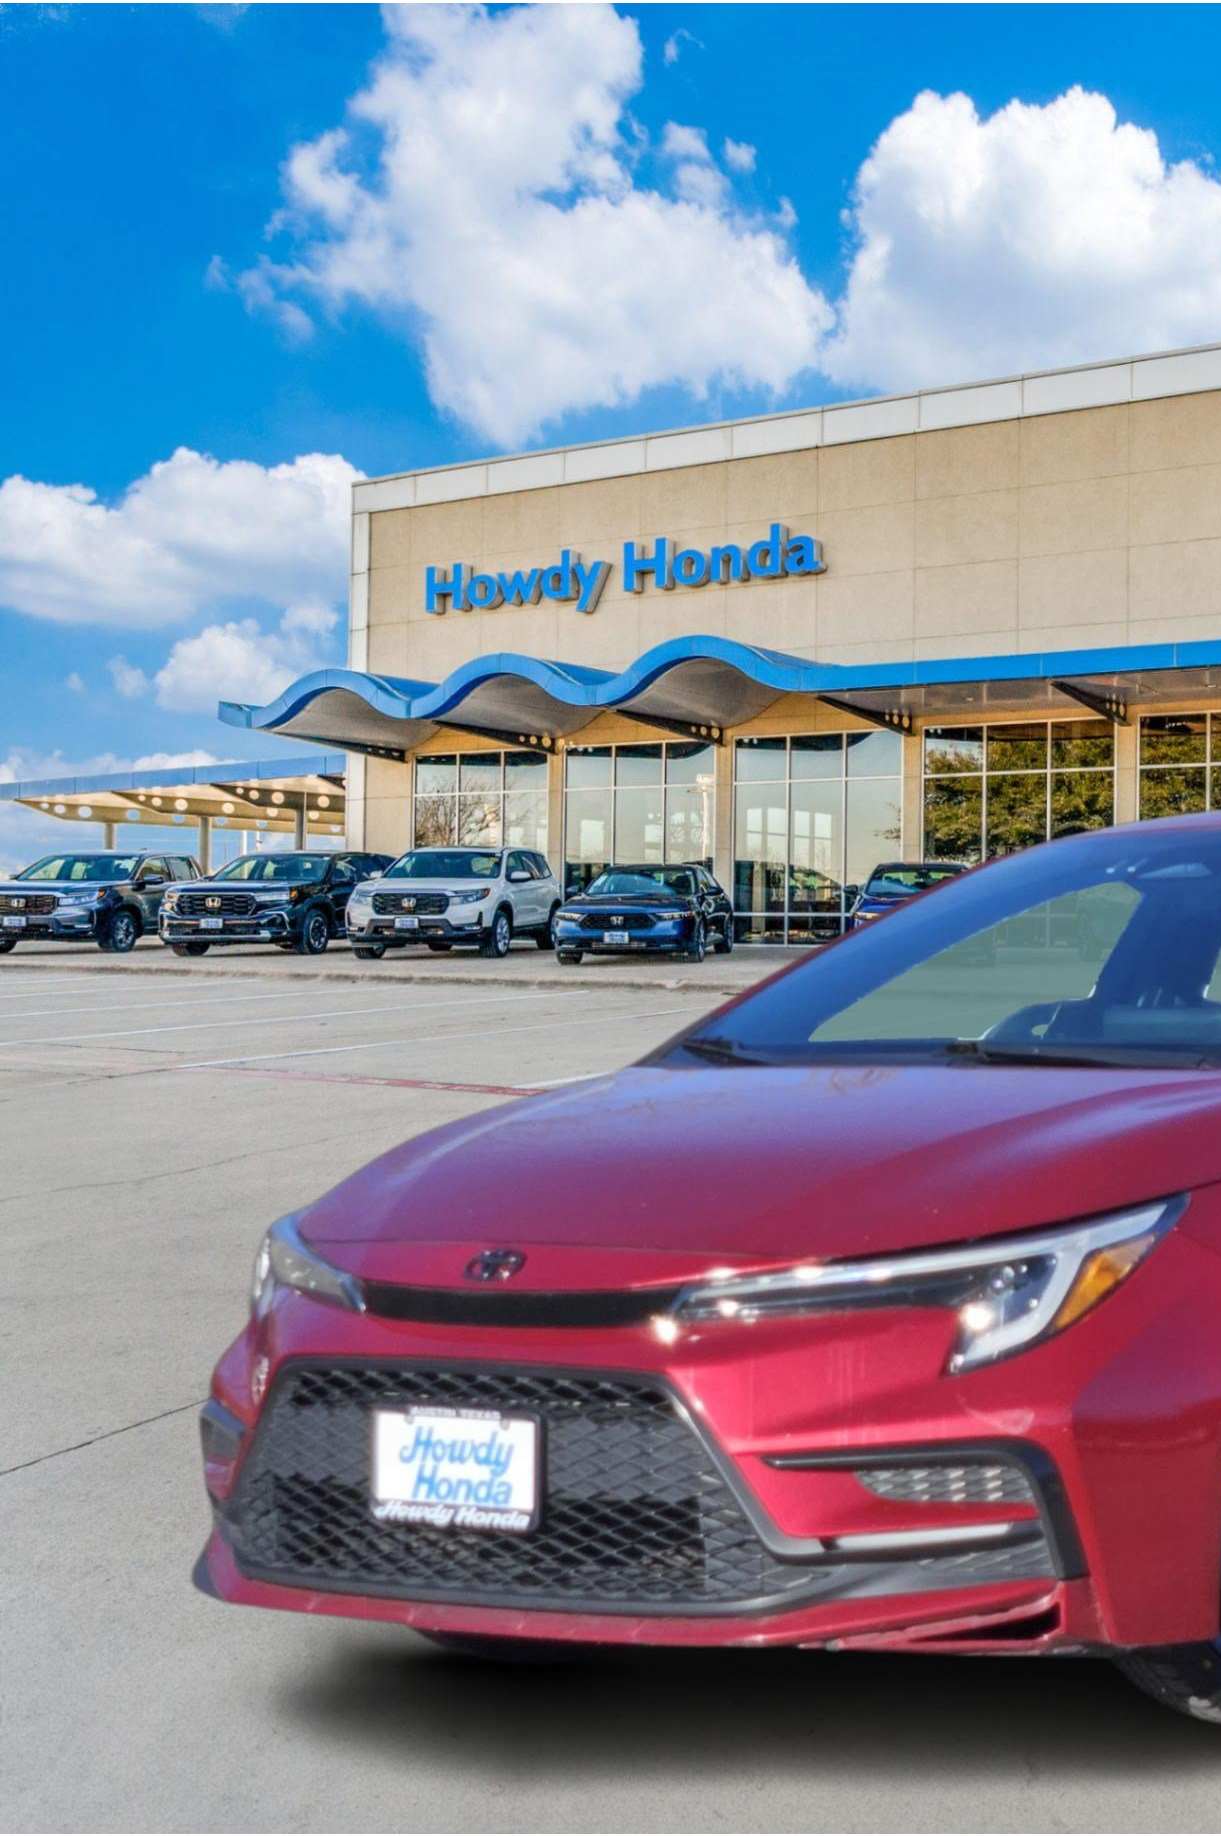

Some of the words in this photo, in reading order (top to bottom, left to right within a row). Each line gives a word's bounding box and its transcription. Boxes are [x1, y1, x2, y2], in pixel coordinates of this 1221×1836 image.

[425, 549, 611, 615] Howdy
[623, 523, 826, 594] Honda
[399, 1426, 514, 1477] Howdy
[412, 1463, 513, 1504] Honda
[373, 1500, 454, 1527] Howdy
[454, 1507, 531, 1531] Honda
